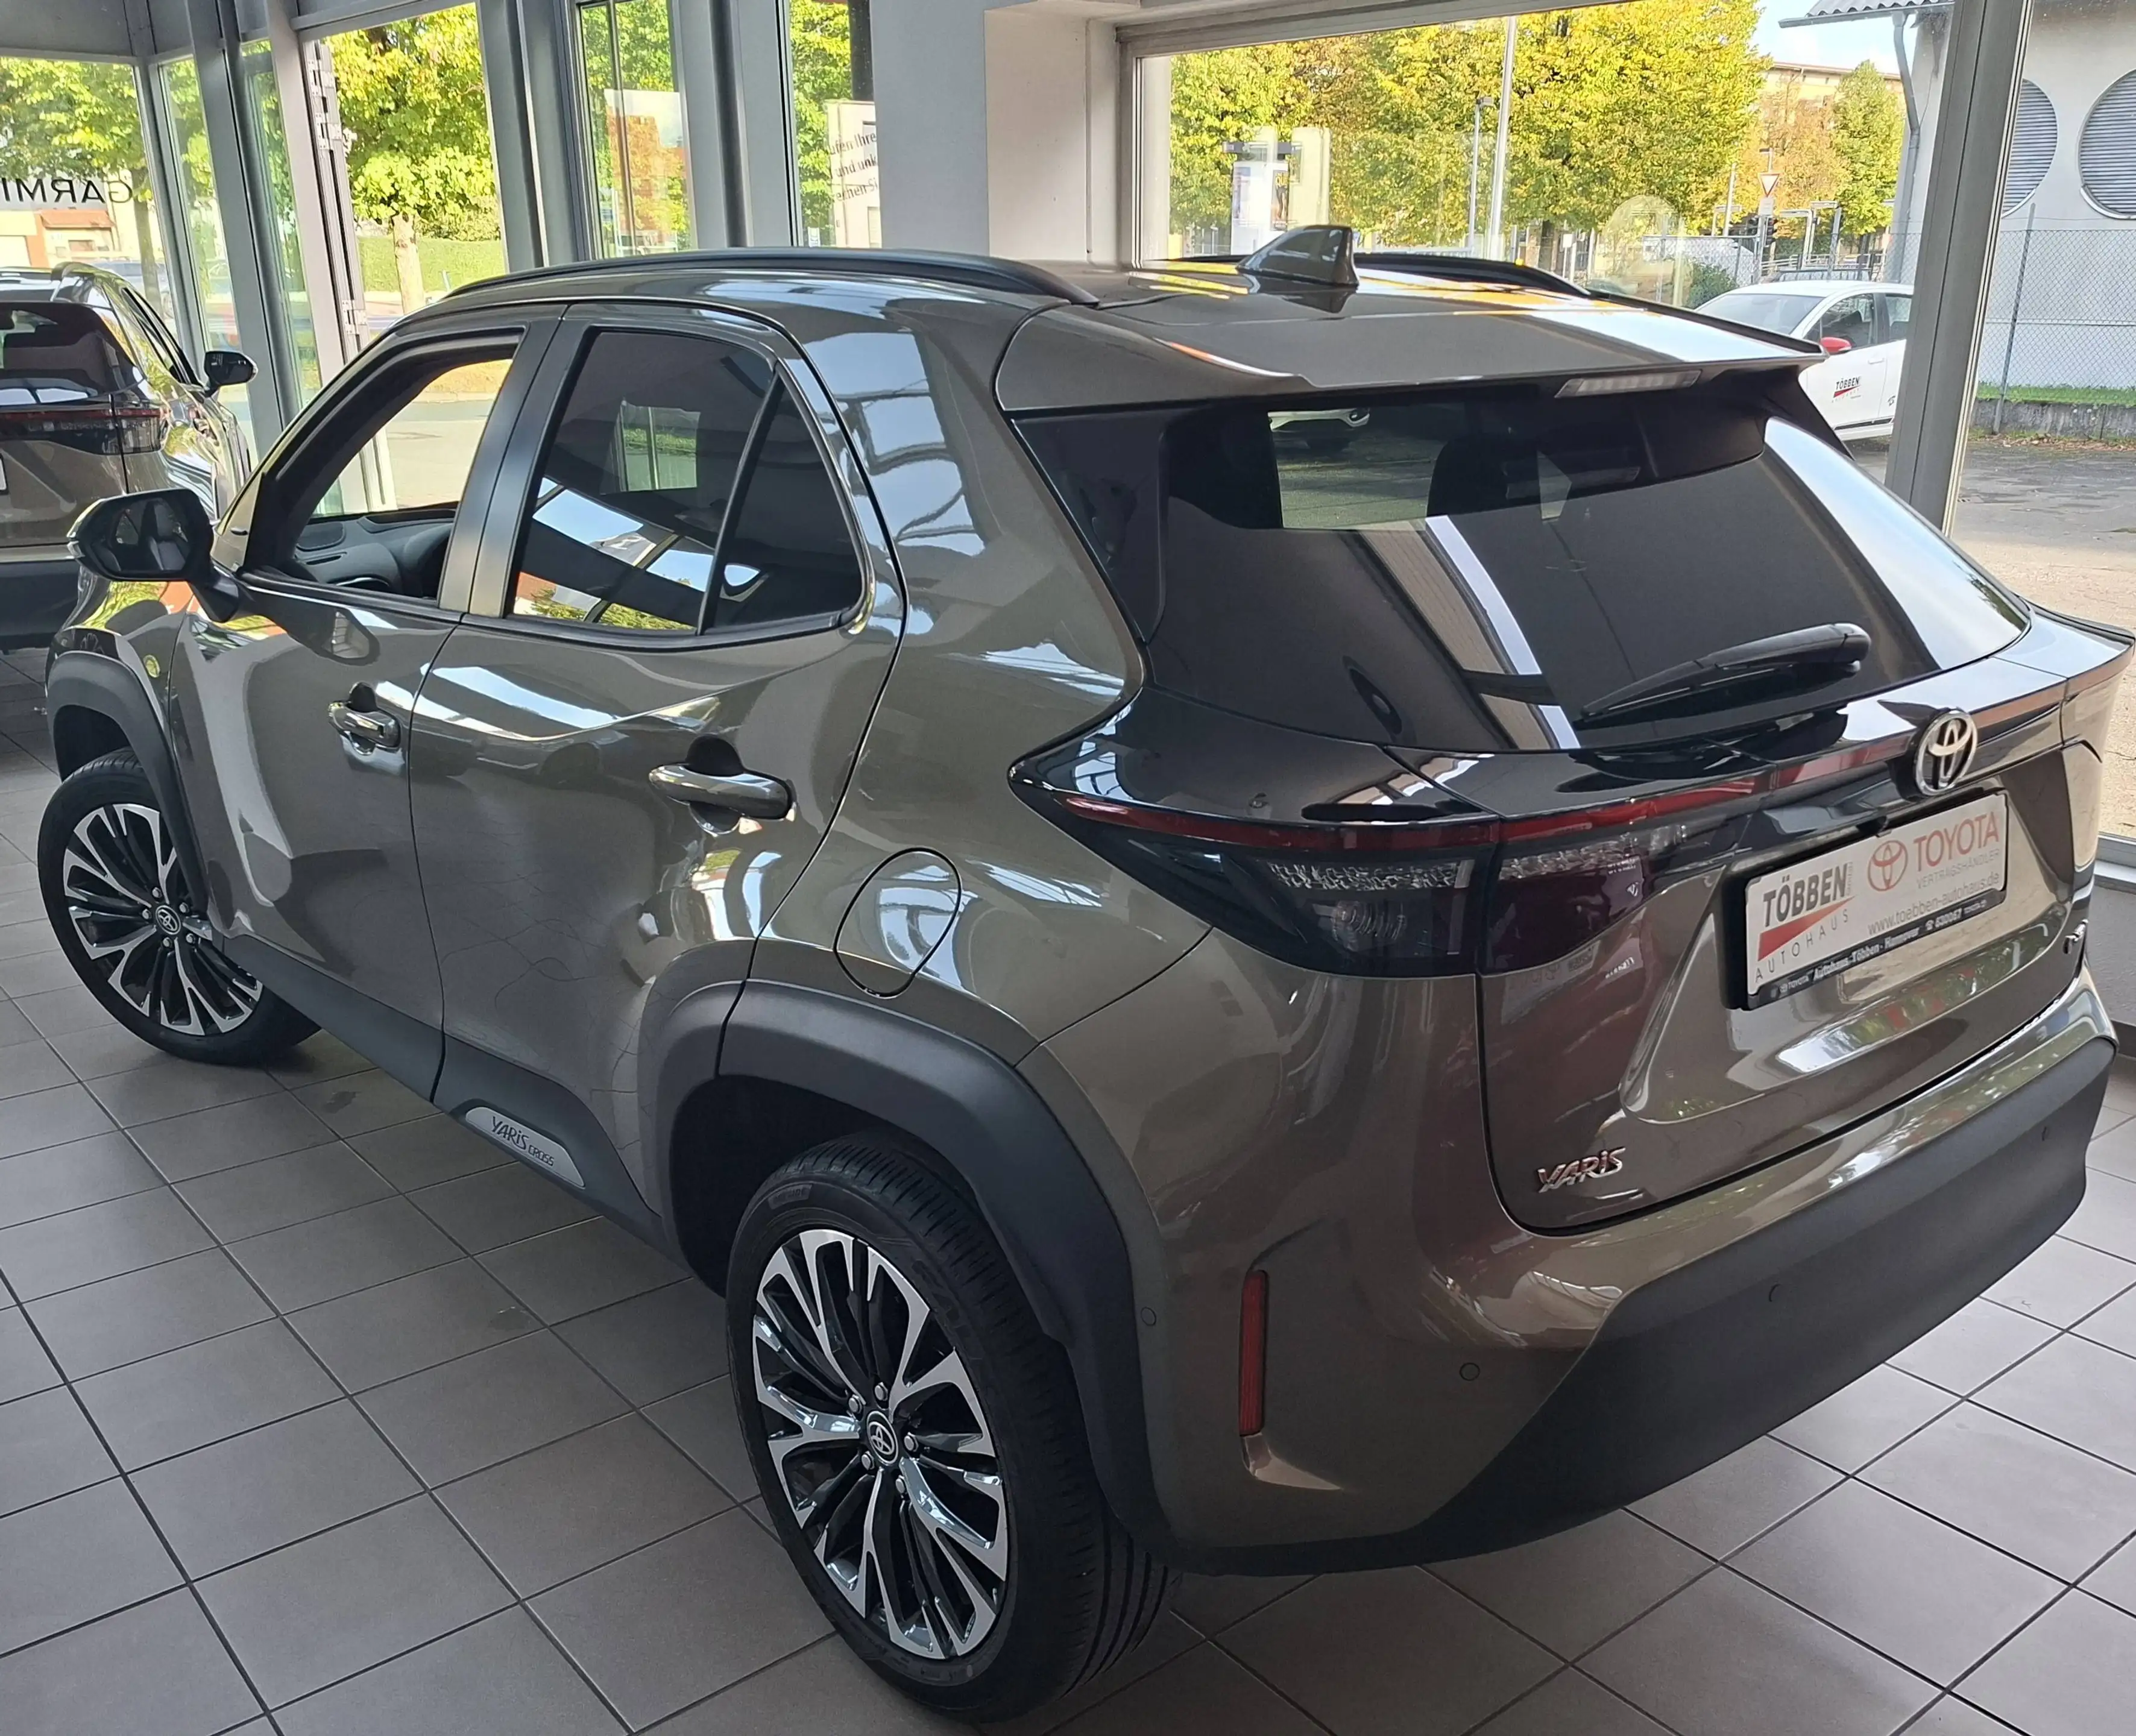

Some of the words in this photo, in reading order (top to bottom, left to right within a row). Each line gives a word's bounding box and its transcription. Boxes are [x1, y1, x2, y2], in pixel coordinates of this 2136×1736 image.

[826, 139, 854, 156] ufen
[1914, 811, 1999, 872] TOYOTA
[1763, 863, 1848, 928] TÖBBEN
[1867, 872, 2000, 935] www.toebben-autohaus.de
[1755, 908, 1849, 983] AUTOHAUS
[528, 1144, 555, 1167] CROSS
